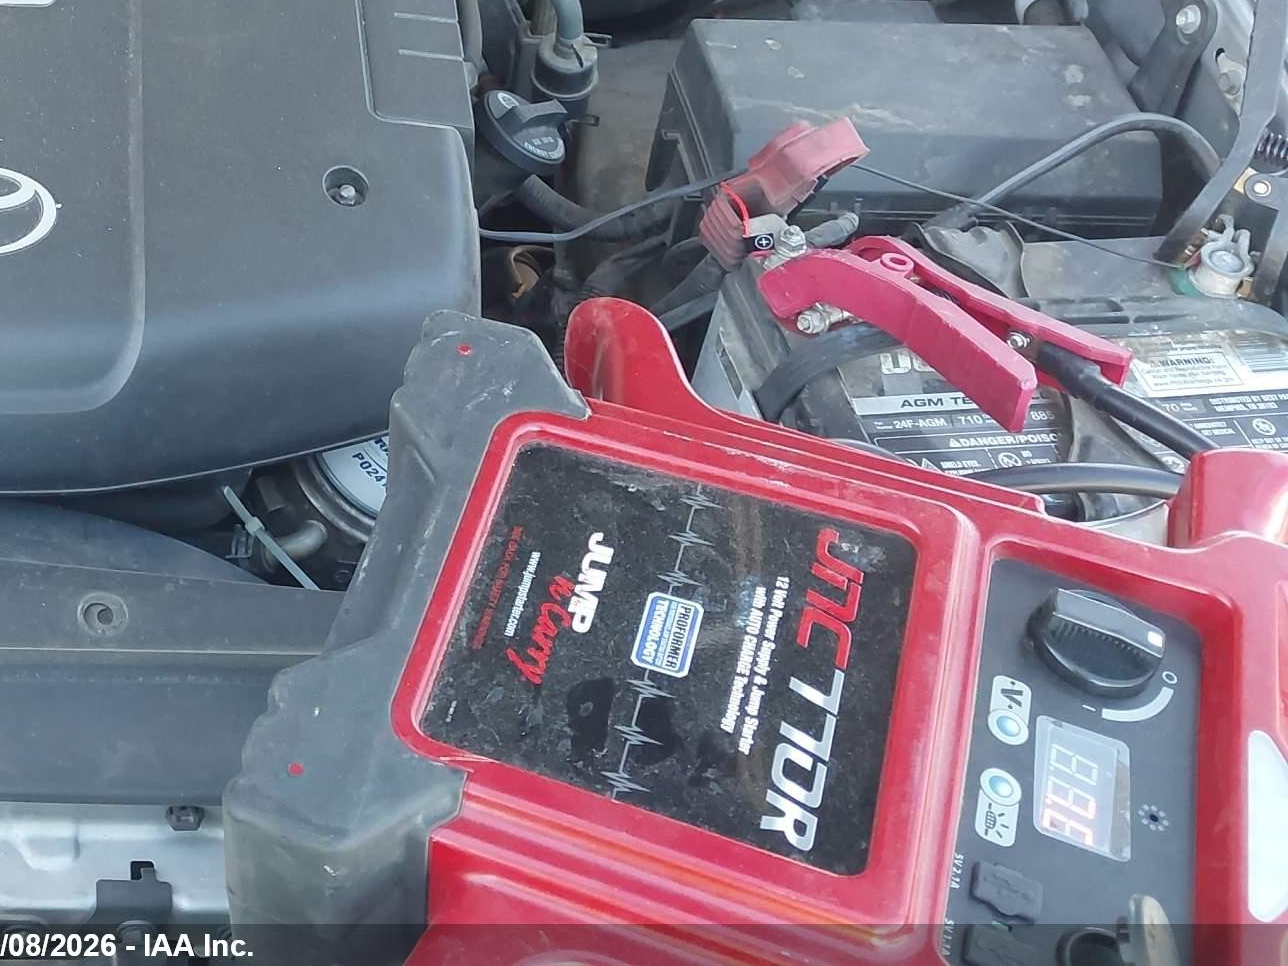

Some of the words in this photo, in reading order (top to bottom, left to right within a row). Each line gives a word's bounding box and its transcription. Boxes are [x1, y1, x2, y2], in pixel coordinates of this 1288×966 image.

[900, 397, 944, 410] AGM
[892, 417, 948, 430] 24F-AGM
[956, 414, 983, 426] 710
[958, 433, 1058, 448] DANGER/POISO
[352, 451, 387, 487] P024
[504, 551, 542, 638] www.jumpstarter.com
[567, 532, 614, 634] JUMP
[752, 586, 768, 610] with
[771, 589, 788, 610] Volt
[775, 576, 790, 589] 12
[641, 599, 670, 664] TECHNOLOGY
[665, 605, 692, 669] PROFORMER
[745, 607, 764, 635] AUTO
[764, 608, 783, 641] Power
[506, 602, 572, 684] Carry
[735, 634, 758, 676] CHARGE
[753, 640, 776, 676] Supply
[753, 675, 768, 686] &
[719, 675, 749, 734] Technology
[744, 685, 765, 717] Jump
[738, 715, 759, 756] Starter
